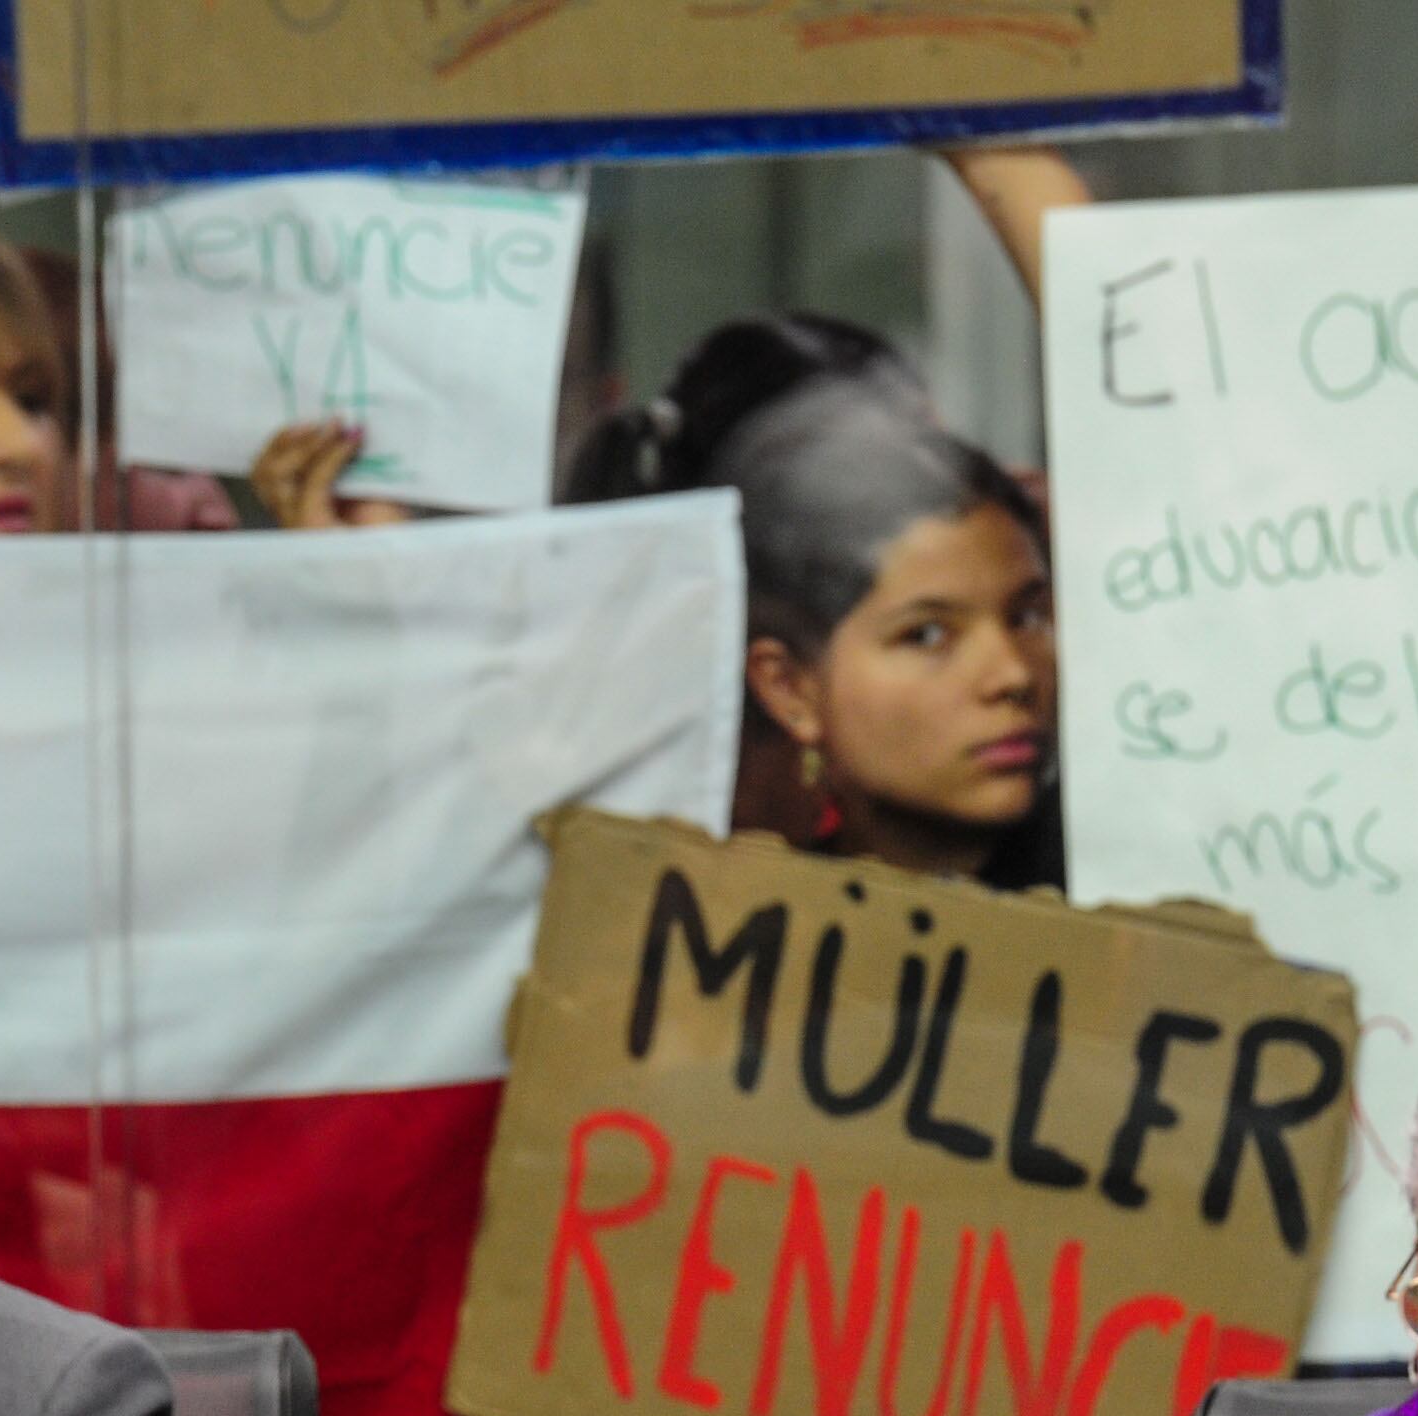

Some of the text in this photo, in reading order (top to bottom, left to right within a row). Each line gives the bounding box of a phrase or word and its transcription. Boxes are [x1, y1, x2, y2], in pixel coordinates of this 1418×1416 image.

[1101, 256, 1231, 408] El
[1113, 678, 1229, 763] se
[1197, 770, 1403, 896] más
[627, 866, 1350, 1258] MÜLLER
